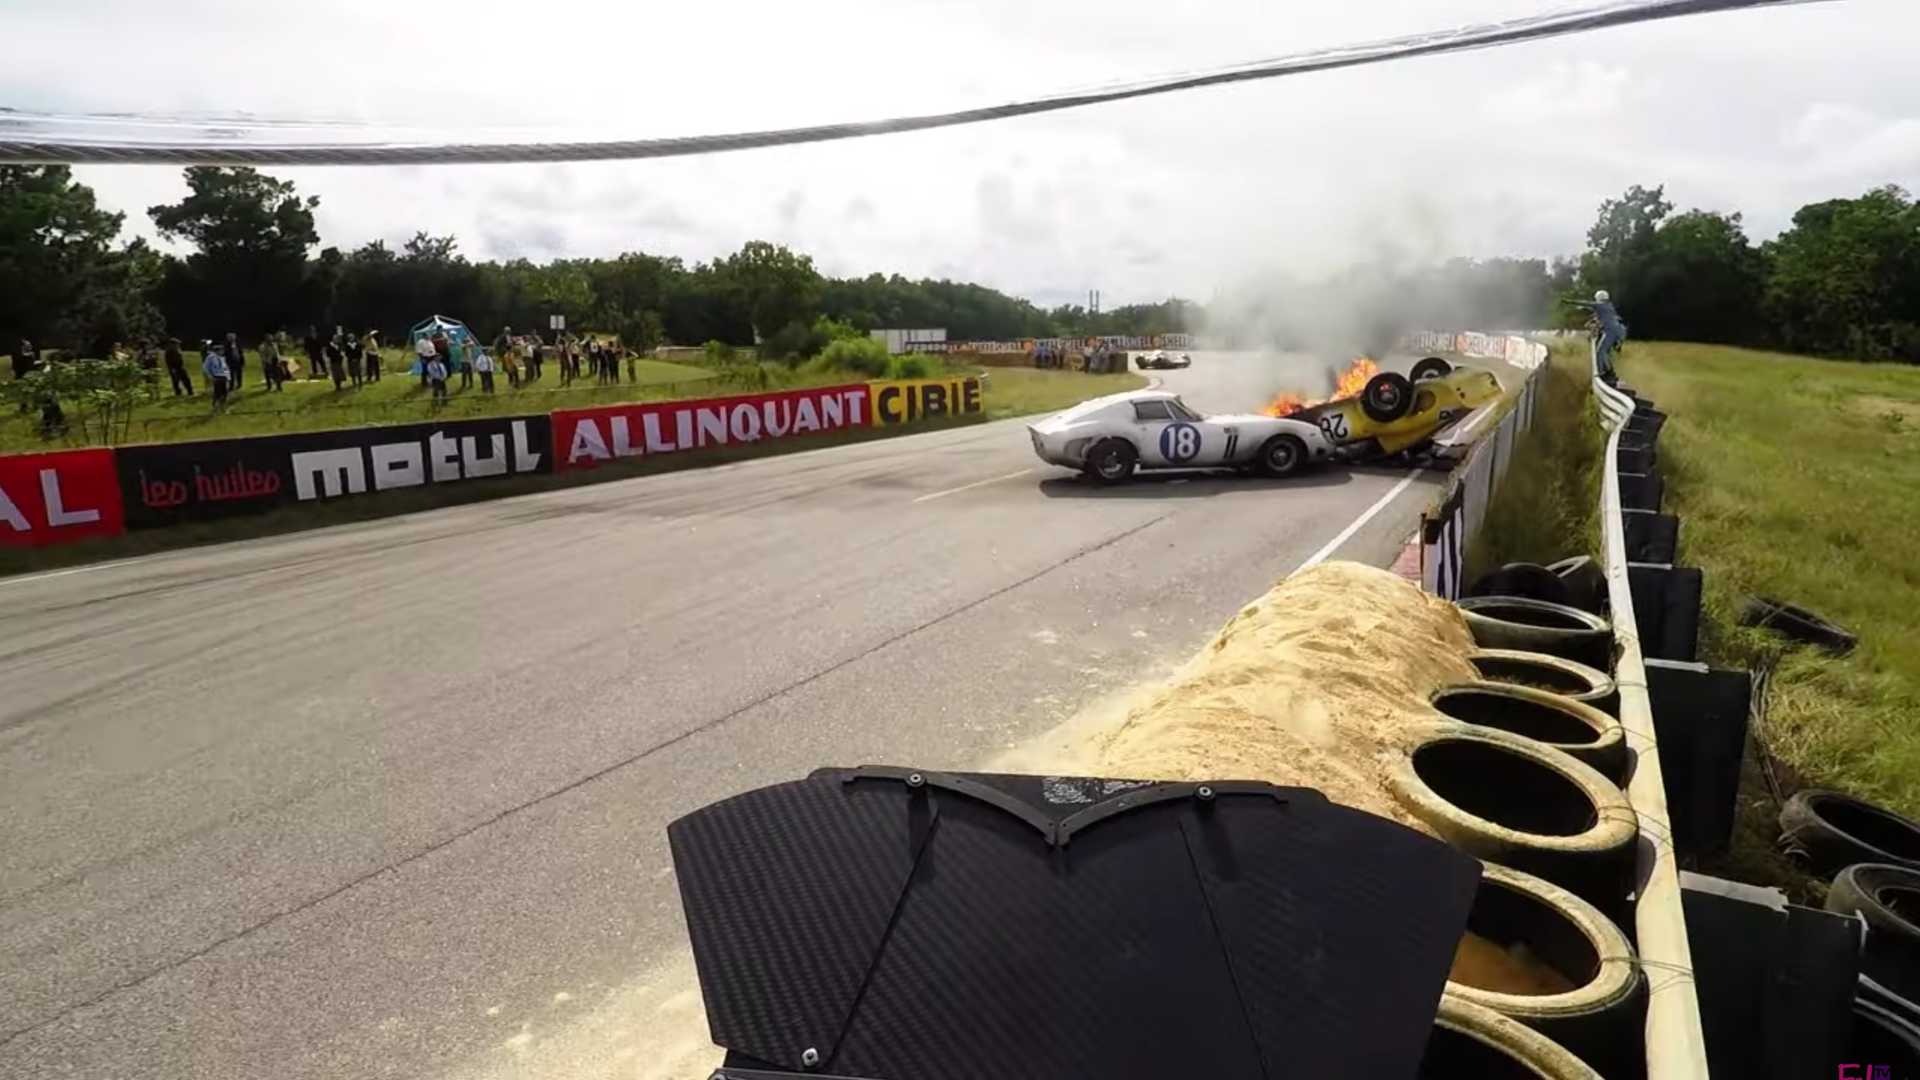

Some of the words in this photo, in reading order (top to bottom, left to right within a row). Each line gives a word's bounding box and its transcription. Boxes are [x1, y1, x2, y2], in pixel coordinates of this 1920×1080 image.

[568, 391, 866, 463] ALLINQUANT
[1166, 426, 1196, 458] 18
[140, 469, 184, 507] les
[194, 461, 280, 501] huiles
